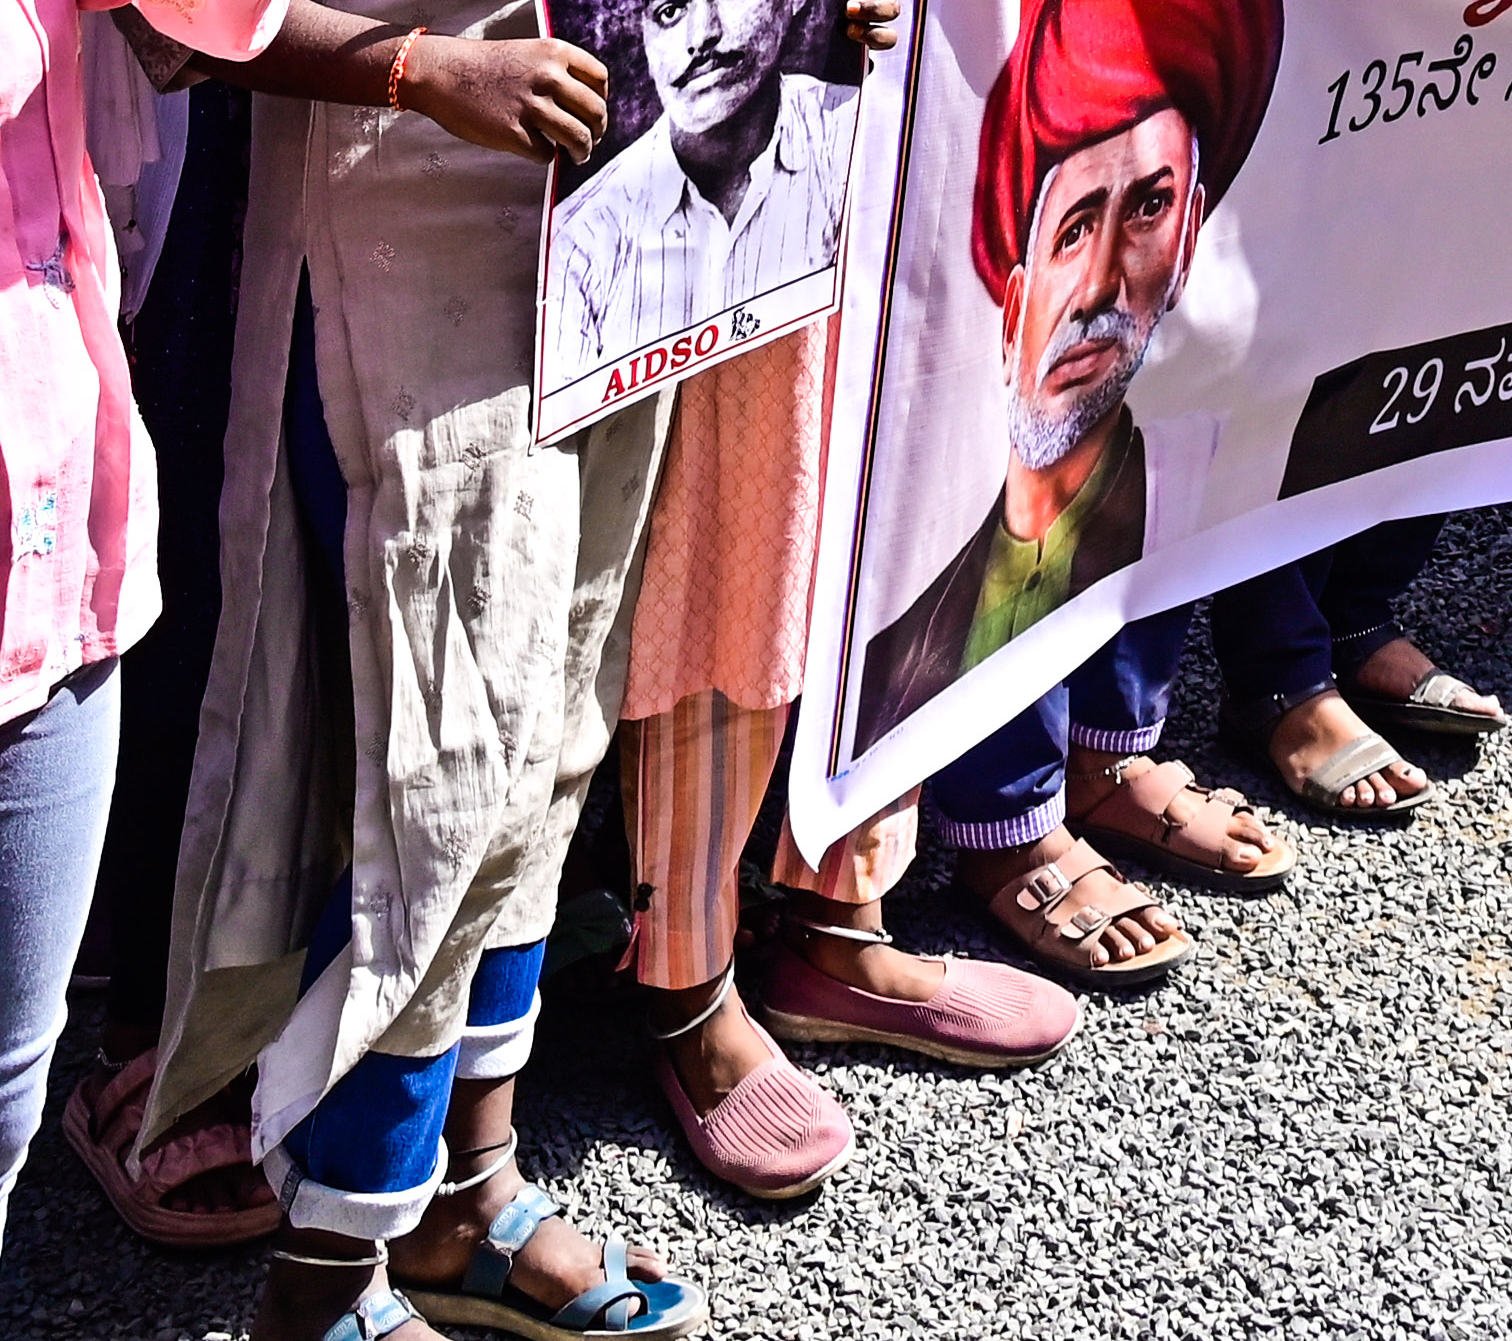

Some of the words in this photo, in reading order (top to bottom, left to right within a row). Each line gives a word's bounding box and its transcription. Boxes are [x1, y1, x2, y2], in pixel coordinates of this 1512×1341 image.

[1318, 34, 1496, 146] 135ನೇ
[601, 325, 720, 402] AIDSO
[1369, 351, 1444, 436] 29
